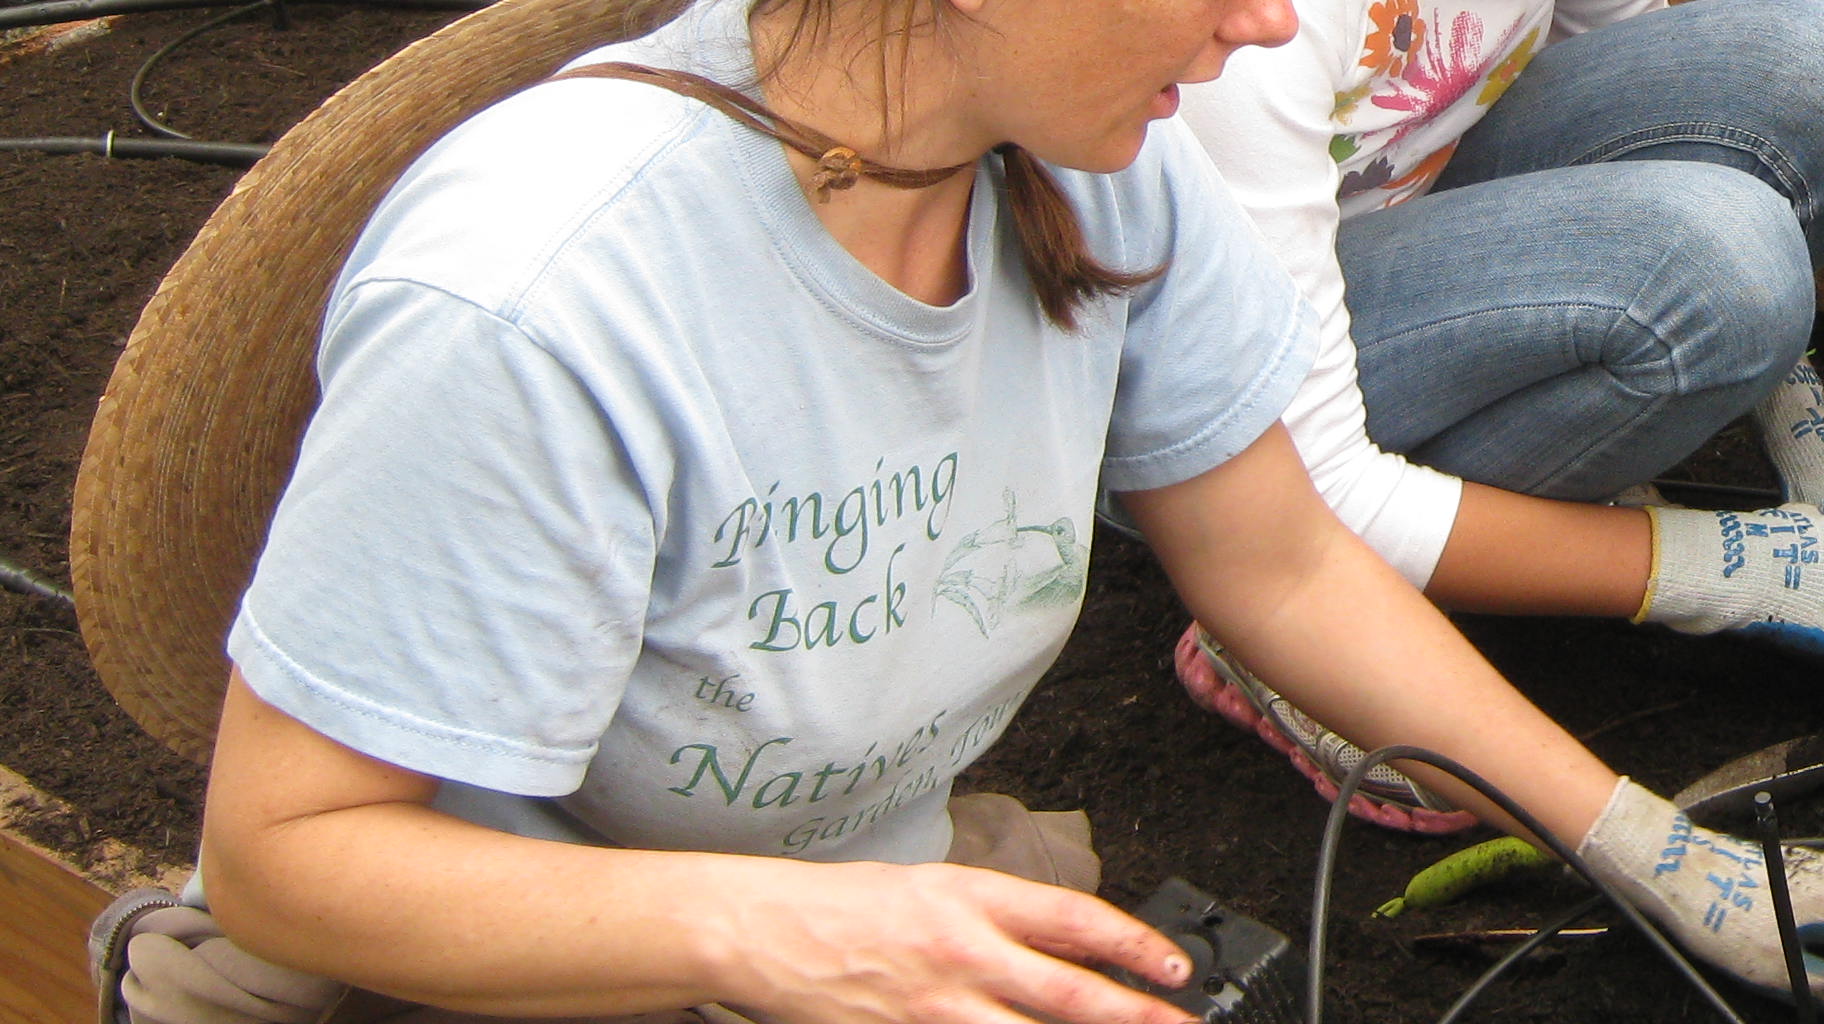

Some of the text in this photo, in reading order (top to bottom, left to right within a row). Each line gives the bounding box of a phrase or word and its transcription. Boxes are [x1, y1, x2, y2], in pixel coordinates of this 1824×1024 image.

[1788, 511, 1819, 564] ATLAS
[747, 542, 911, 652] Back
[694, 673, 756, 713] the
[667, 709, 948, 809] Natives
[781, 764, 941, 855] Garden
